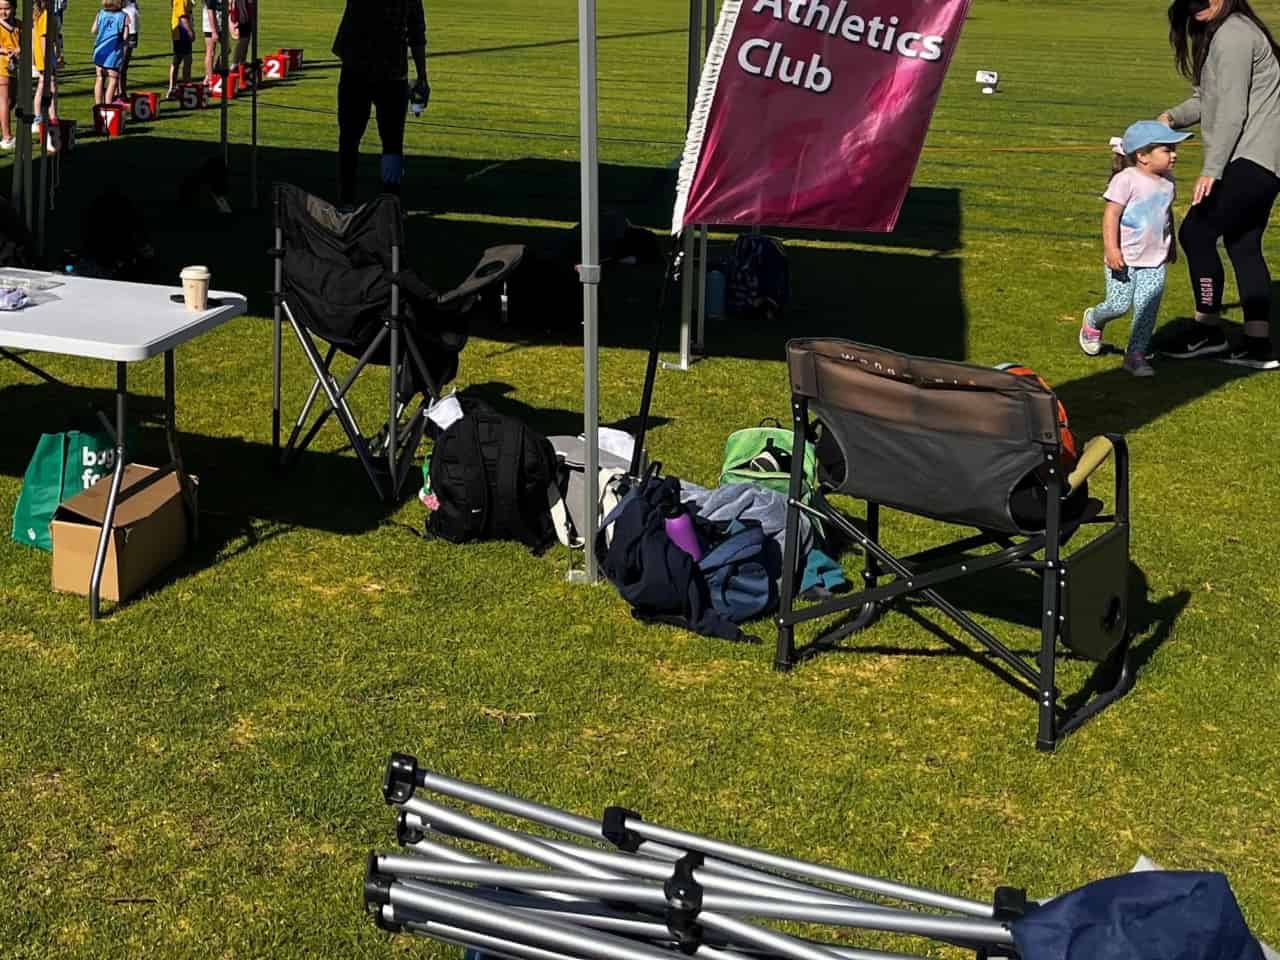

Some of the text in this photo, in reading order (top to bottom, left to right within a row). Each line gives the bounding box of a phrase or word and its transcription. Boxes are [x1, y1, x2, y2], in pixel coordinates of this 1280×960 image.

[268, 59, 280, 79] 2
[736, 38, 833, 93] Club
[134, 96, 151, 119] 6
[183, 86, 198, 108] 5
